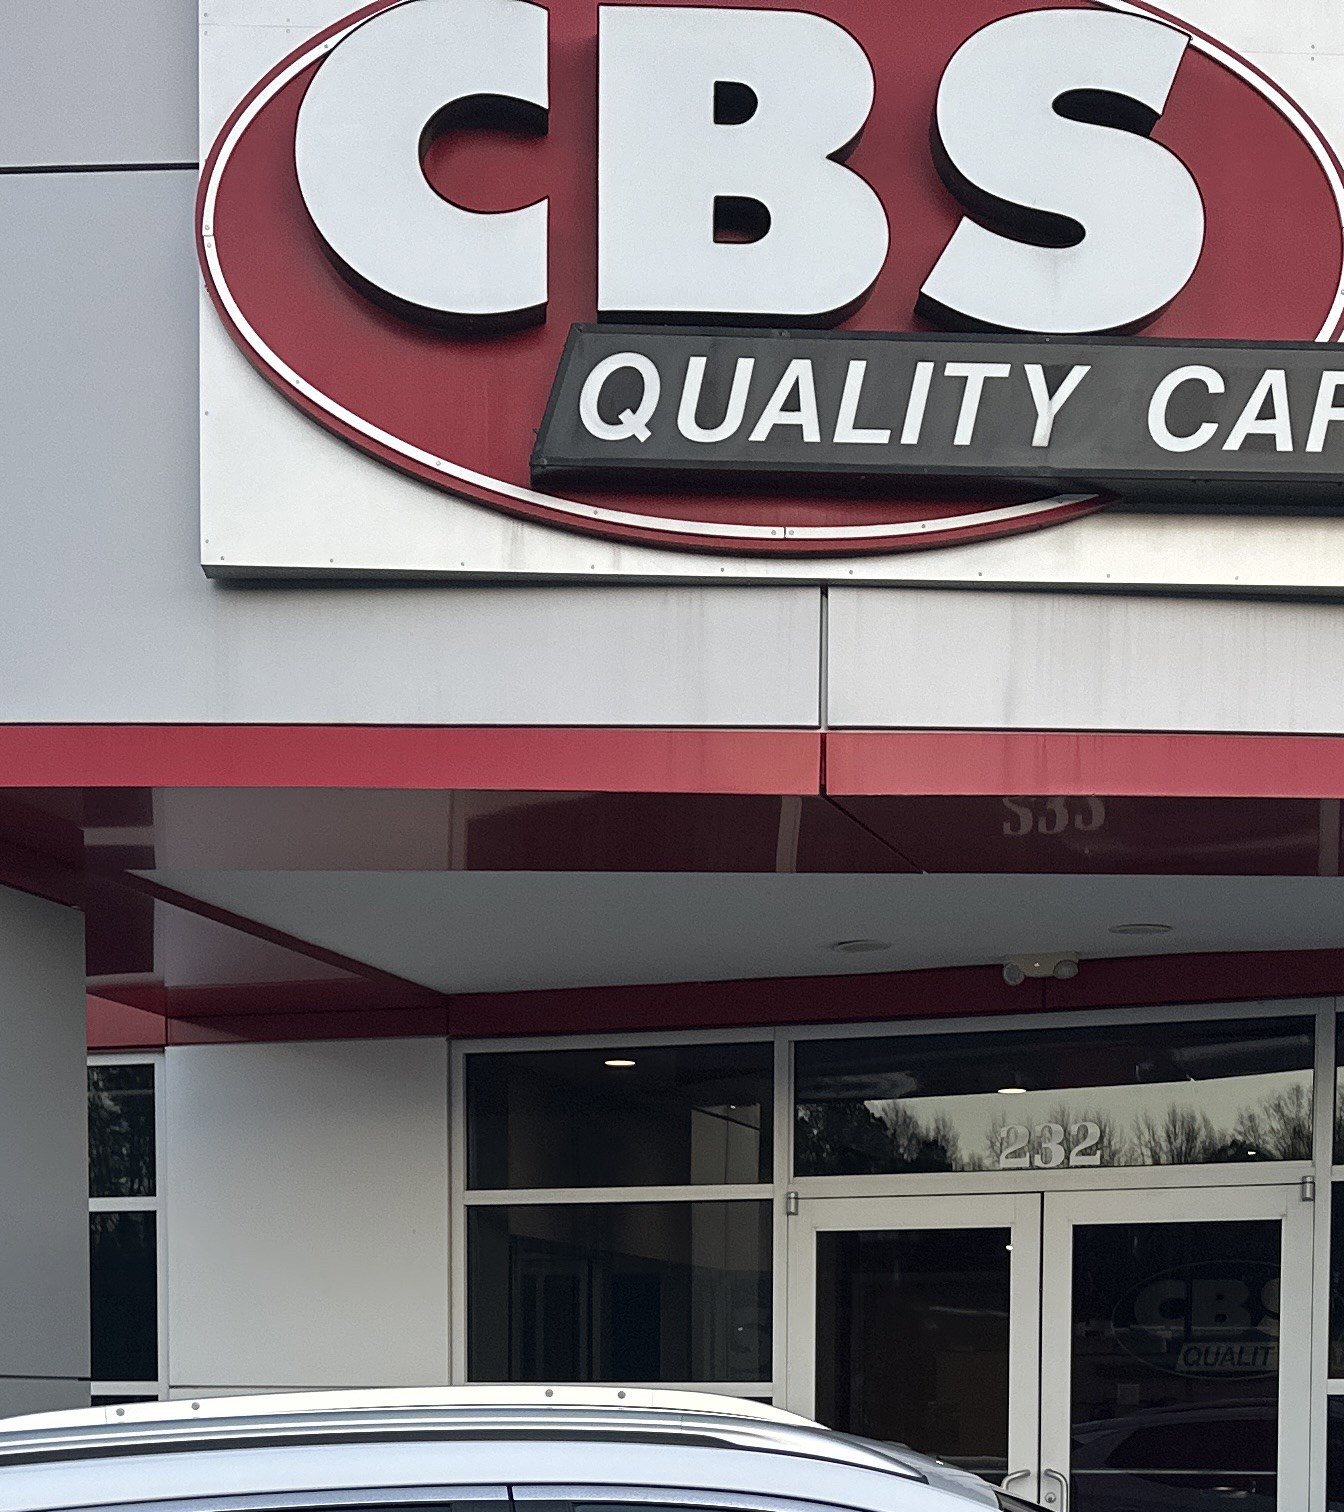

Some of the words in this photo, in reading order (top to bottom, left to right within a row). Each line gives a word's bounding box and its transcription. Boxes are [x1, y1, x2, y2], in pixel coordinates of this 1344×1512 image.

[293, 0, 1206, 334] CBS
[577, 351, 1090, 450] QUALITY
[999, 1121, 1102, 1168] 232
[1182, 1345, 1277, 1367] QUALIT
